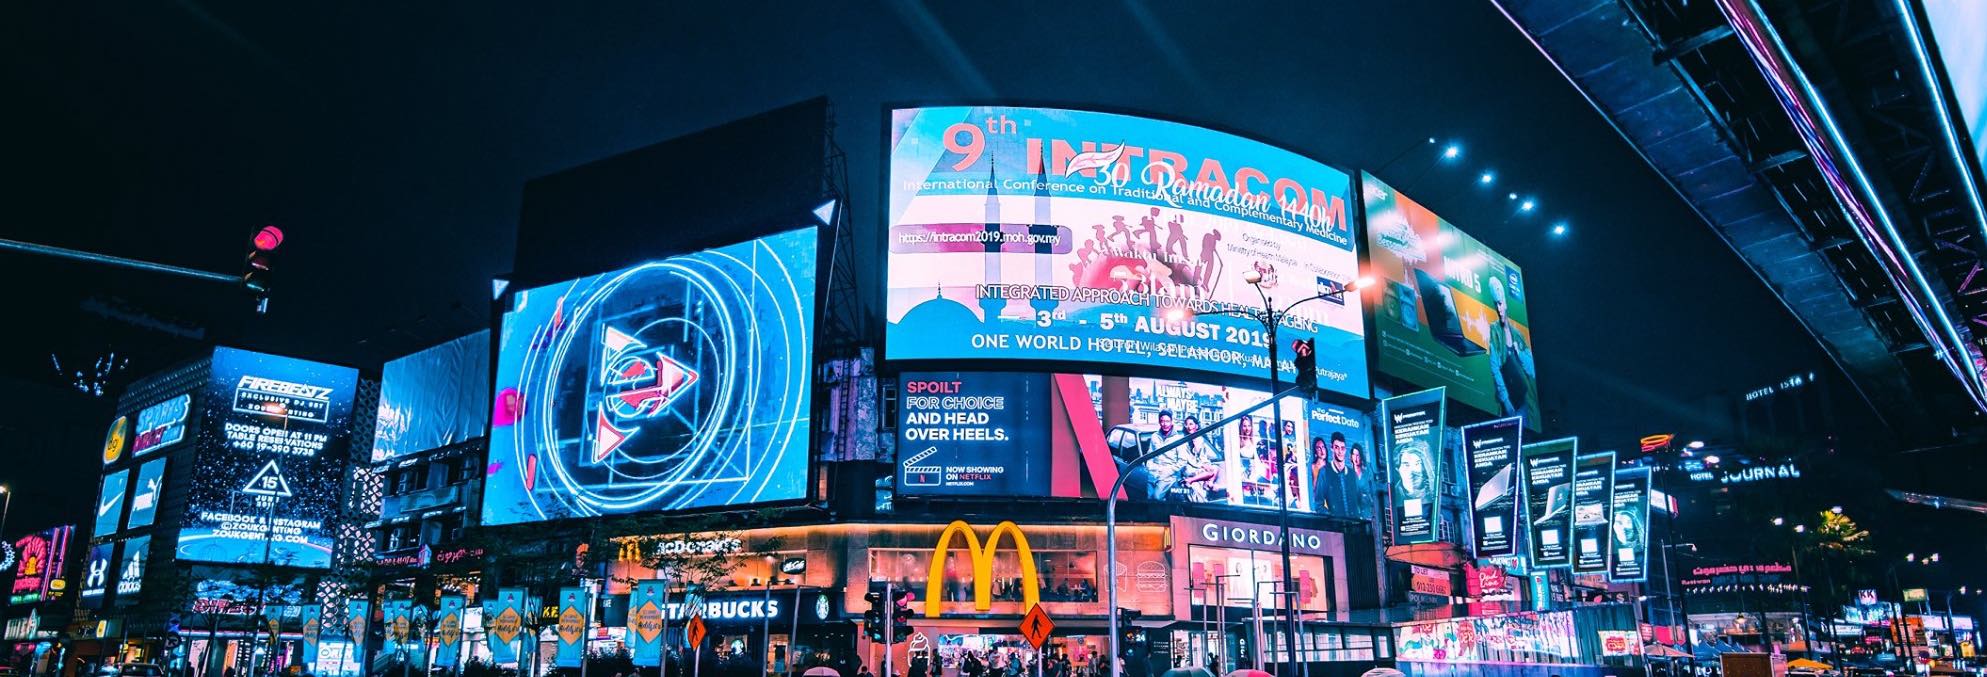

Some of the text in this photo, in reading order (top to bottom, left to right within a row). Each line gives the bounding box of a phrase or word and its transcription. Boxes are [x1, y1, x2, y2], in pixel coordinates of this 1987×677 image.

[943, 115, 1347, 232] 9th INTRACOM
[1094, 162, 1130, 188] 30
[1141, 161, 1271, 213] Ramadan
[903, 178, 998, 191] International
[1003, 179, 1085, 193] Conference
[1089, 185, 1106, 195] on
[1187, 196, 1210, 208] and
[1214, 201, 1303, 232] Complementary
[1306, 225, 1347, 245] Medicine
[975, 284, 1069, 301] INTEGRATED
[1071, 287, 1150, 307] APPROACH
[1153, 294, 1218, 313] TOWARDS
[1278, 314, 1318, 333] AGEING
[1036, 309, 1066, 327] 3rd
[1100, 312, 1128, 330] 5th
[1135, 316, 1220, 341] AUGUST
[1225, 326, 1271, 349] 2019
[971, 333, 1010, 349] ONE
[1015, 334, 1081, 351] WORLD
[237, 375, 334, 400] FIREBEATZ
[907, 381, 962, 393] SPOILT
[906, 396, 1004, 410] FOR CHOICE
[905, 412, 989, 425] AND HEAD
[1312, 410, 1360, 429] Perfect Date
[225, 422, 260, 434] DOORS
[290, 431, 302, 440] AT
[313, 434, 328, 443] PM
[227, 431, 255, 442] TABLE
[905, 428, 1009, 441] OVER HEELS.
[232, 440, 254, 450] +60
[256, 442, 290, 454] 19-390
[946, 466, 965, 474] NOW
[261, 475, 278, 489] 15
[201, 512, 256, 523] FACEBOOK
[268, 517, 321, 528] NSTAGRAM
[661, 600, 778, 620] TRBUCKS
